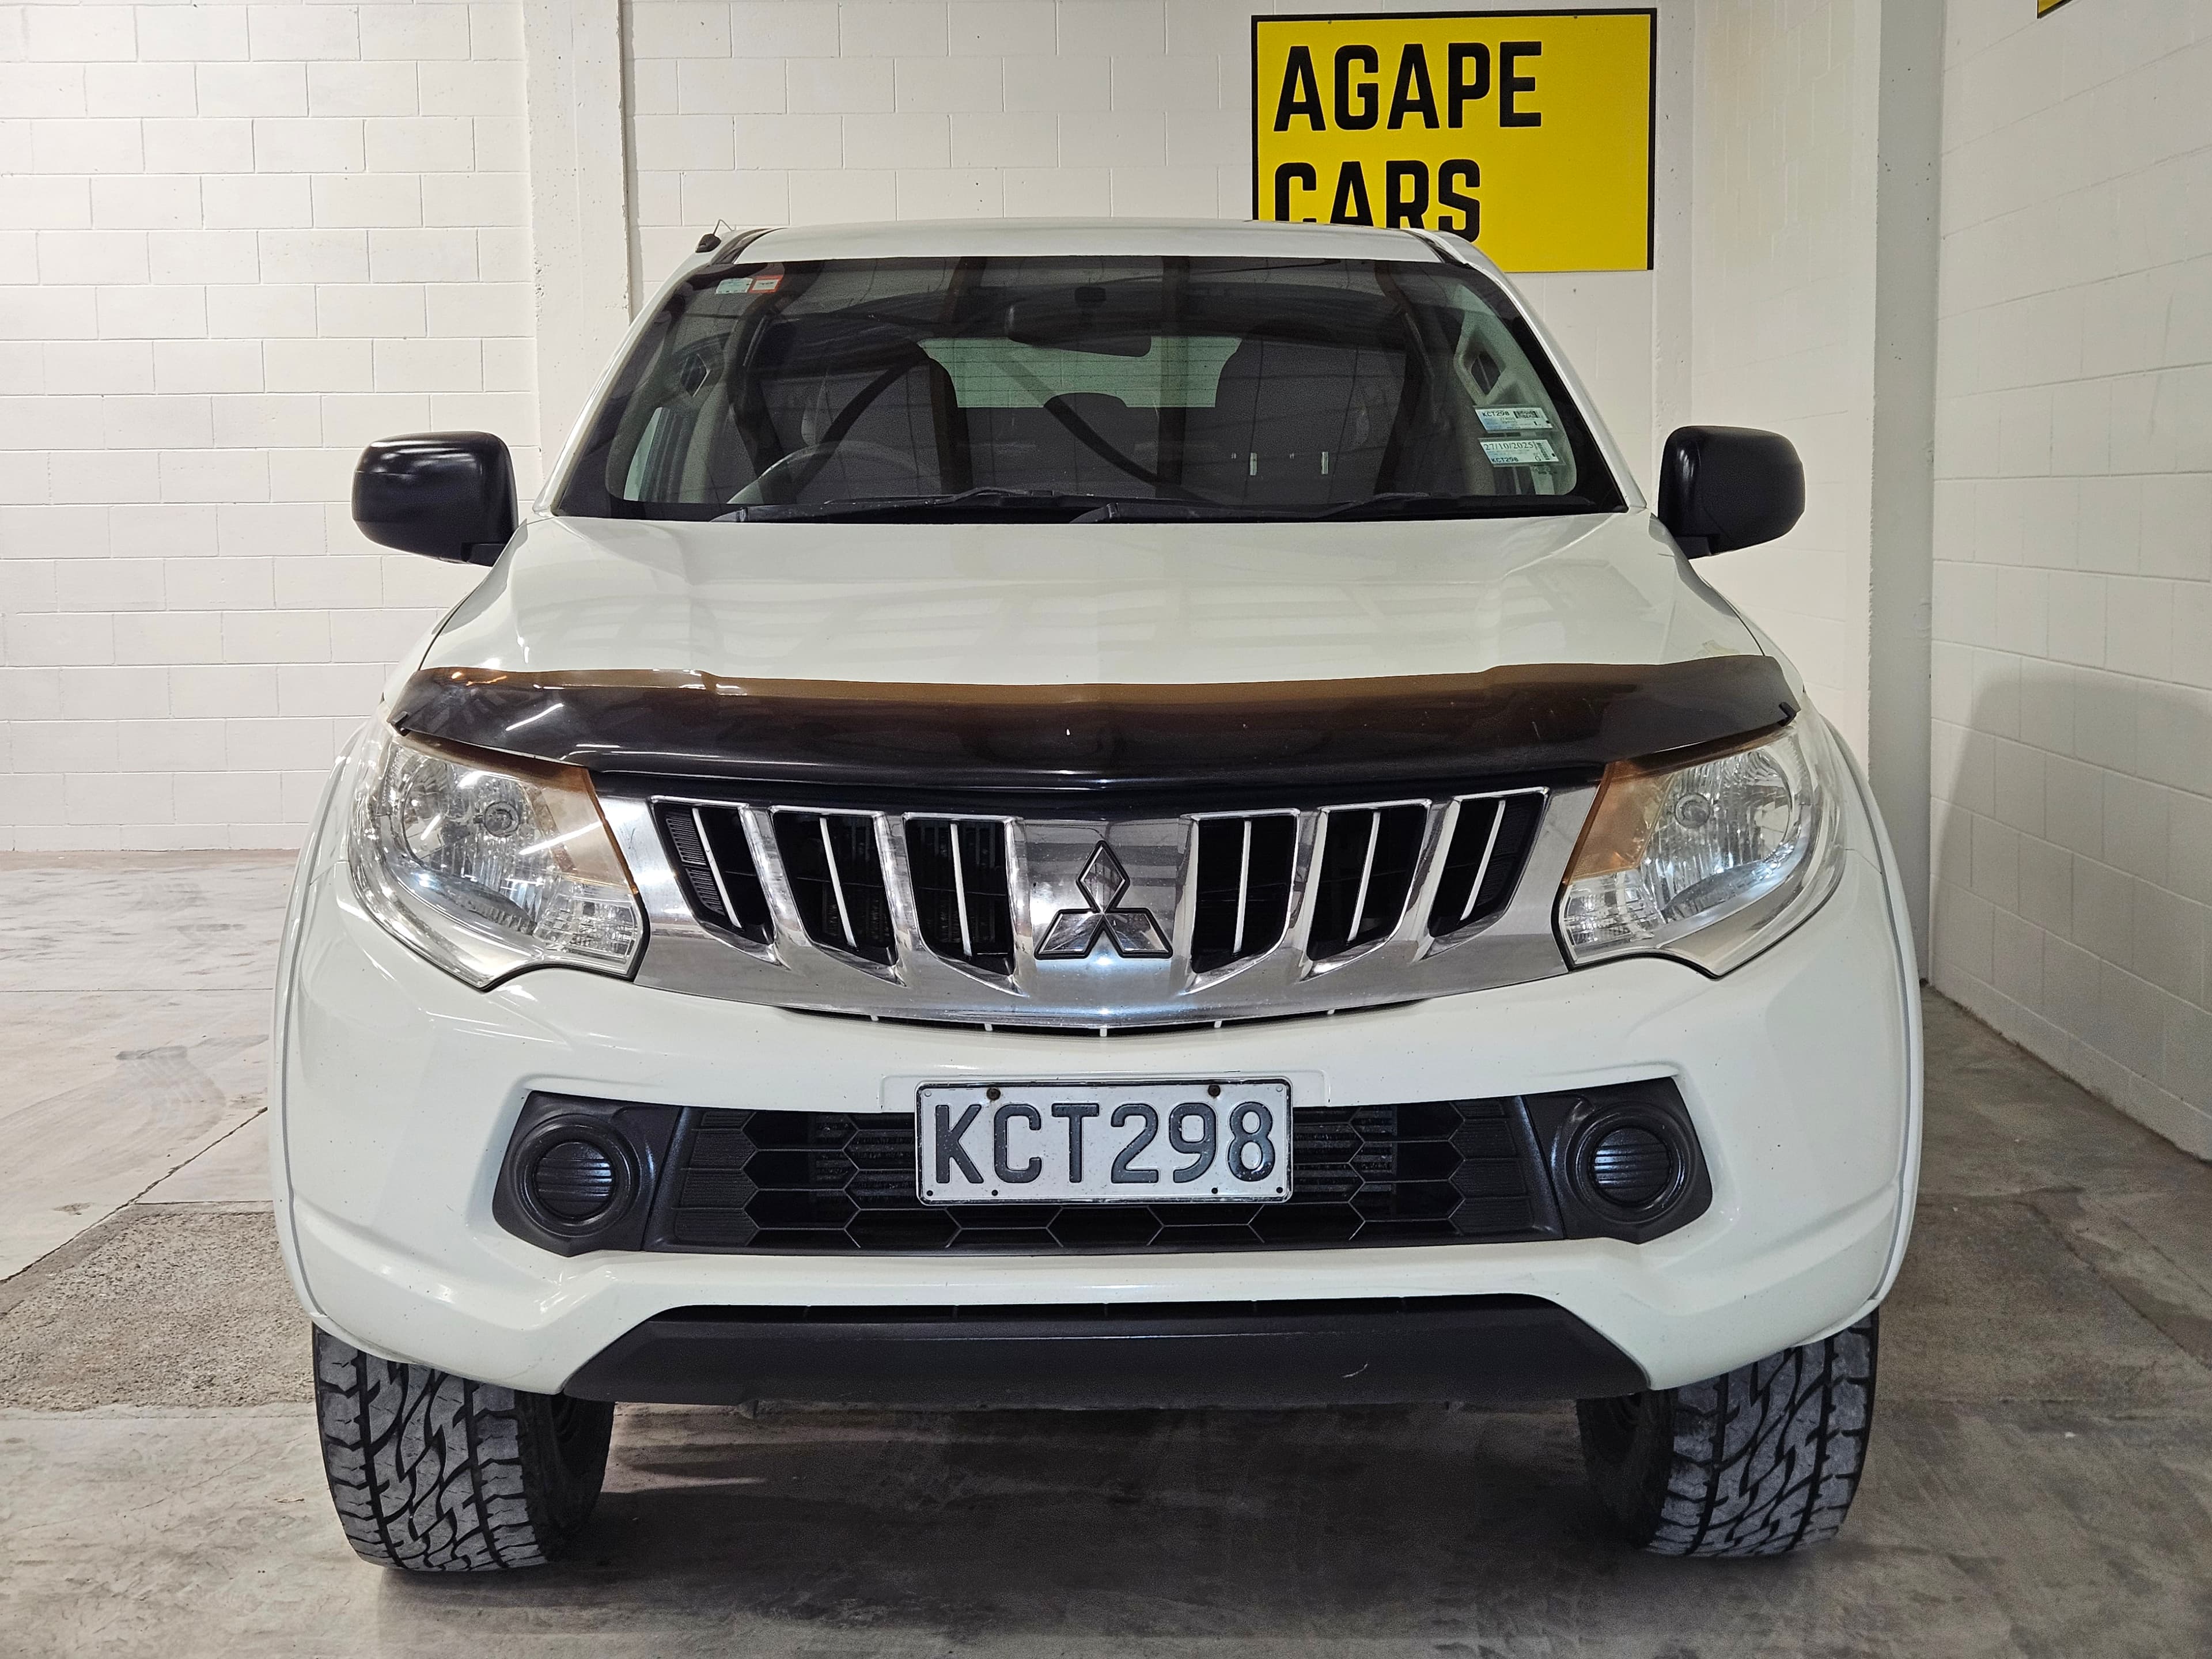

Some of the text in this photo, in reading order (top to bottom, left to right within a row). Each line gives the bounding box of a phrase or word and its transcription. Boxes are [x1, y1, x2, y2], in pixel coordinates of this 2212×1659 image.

[1274, 41, 1542, 132] AGAPE
[1274, 158, 1480, 243] CARS
[1484, 441, 1533, 450] 27/10/2025
[935, 1101, 1276, 1183] KCT298
